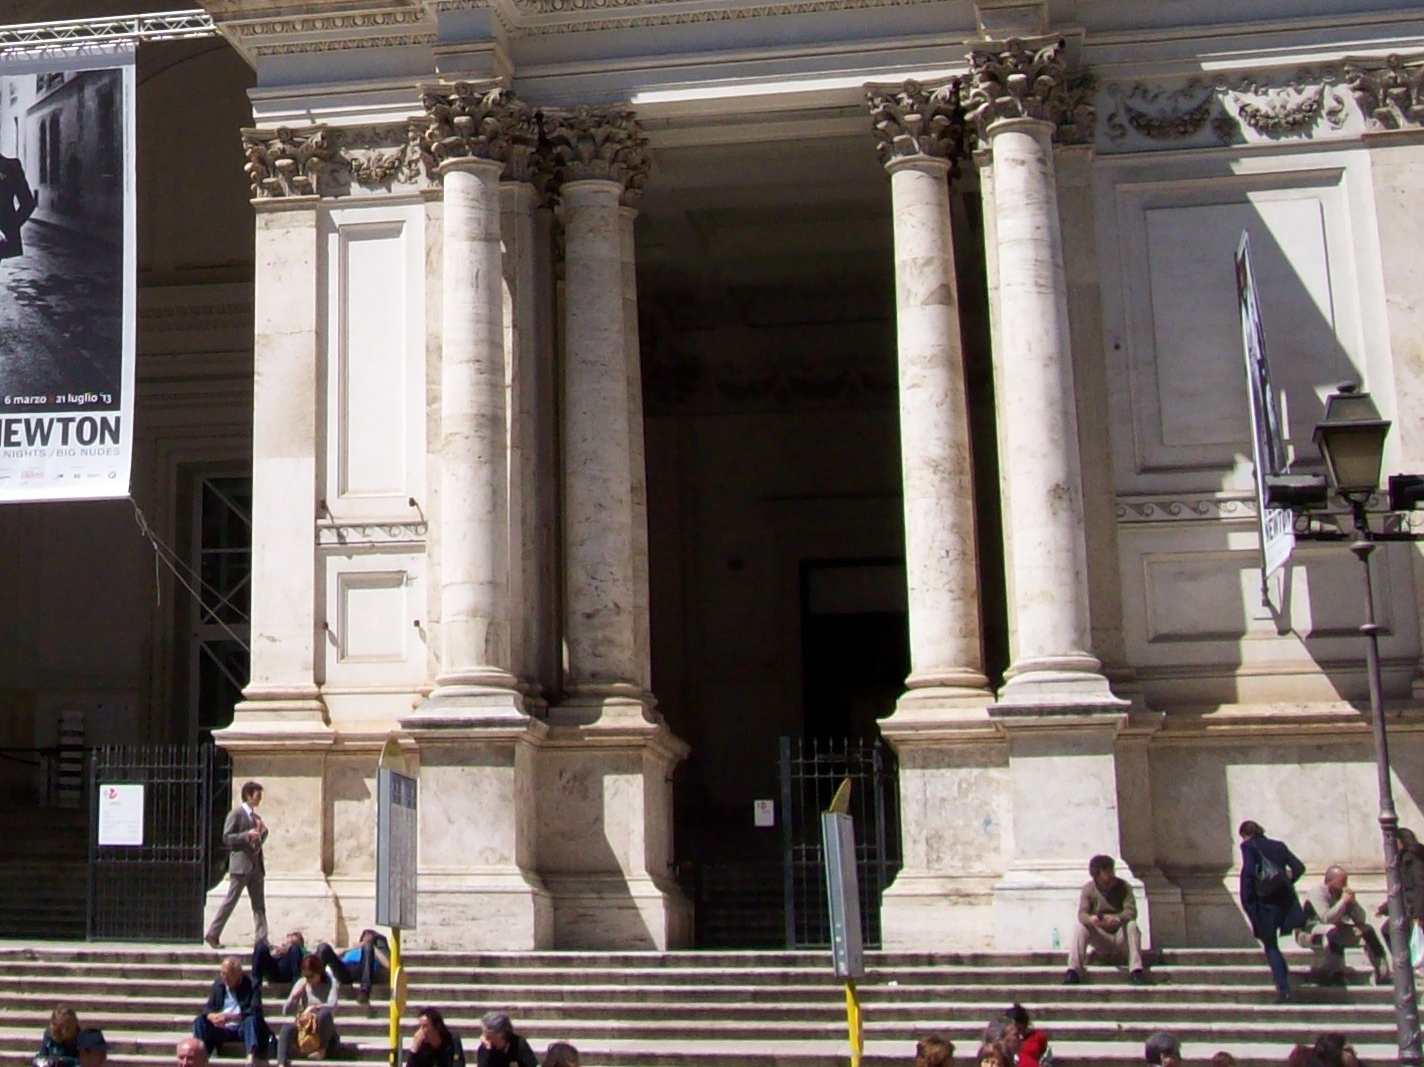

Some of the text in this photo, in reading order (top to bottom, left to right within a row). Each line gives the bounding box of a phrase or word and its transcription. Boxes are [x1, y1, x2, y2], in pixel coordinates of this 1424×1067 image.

[4, 395, 11, 404] 6
[13, 395, 47, 404] marzo
[67, 392, 98, 405] luglio
[80, 446, 121, 456] NUDES
